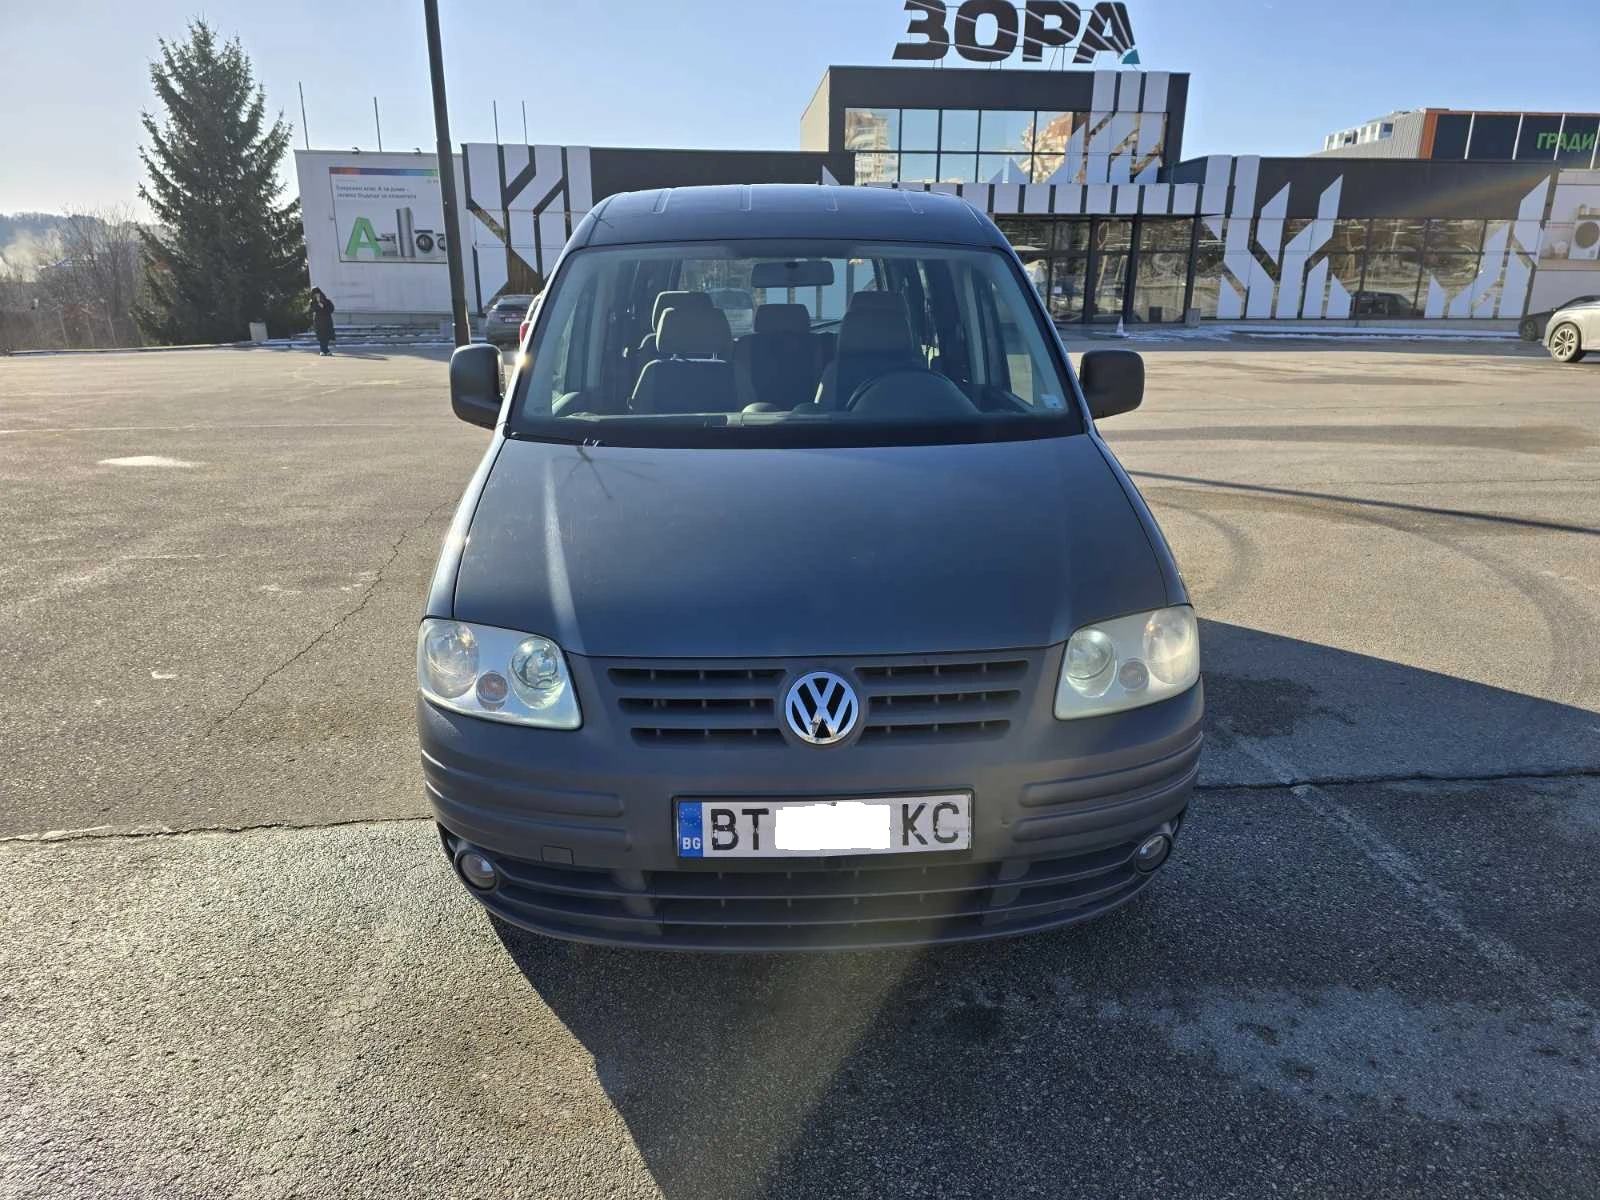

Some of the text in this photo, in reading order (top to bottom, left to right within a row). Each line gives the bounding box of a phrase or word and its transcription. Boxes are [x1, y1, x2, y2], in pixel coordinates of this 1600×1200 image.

[892, 0, 1140, 64] ЗОРА
[682, 836, 701, 850] BG
[710, 801, 960, 850] BT KC
